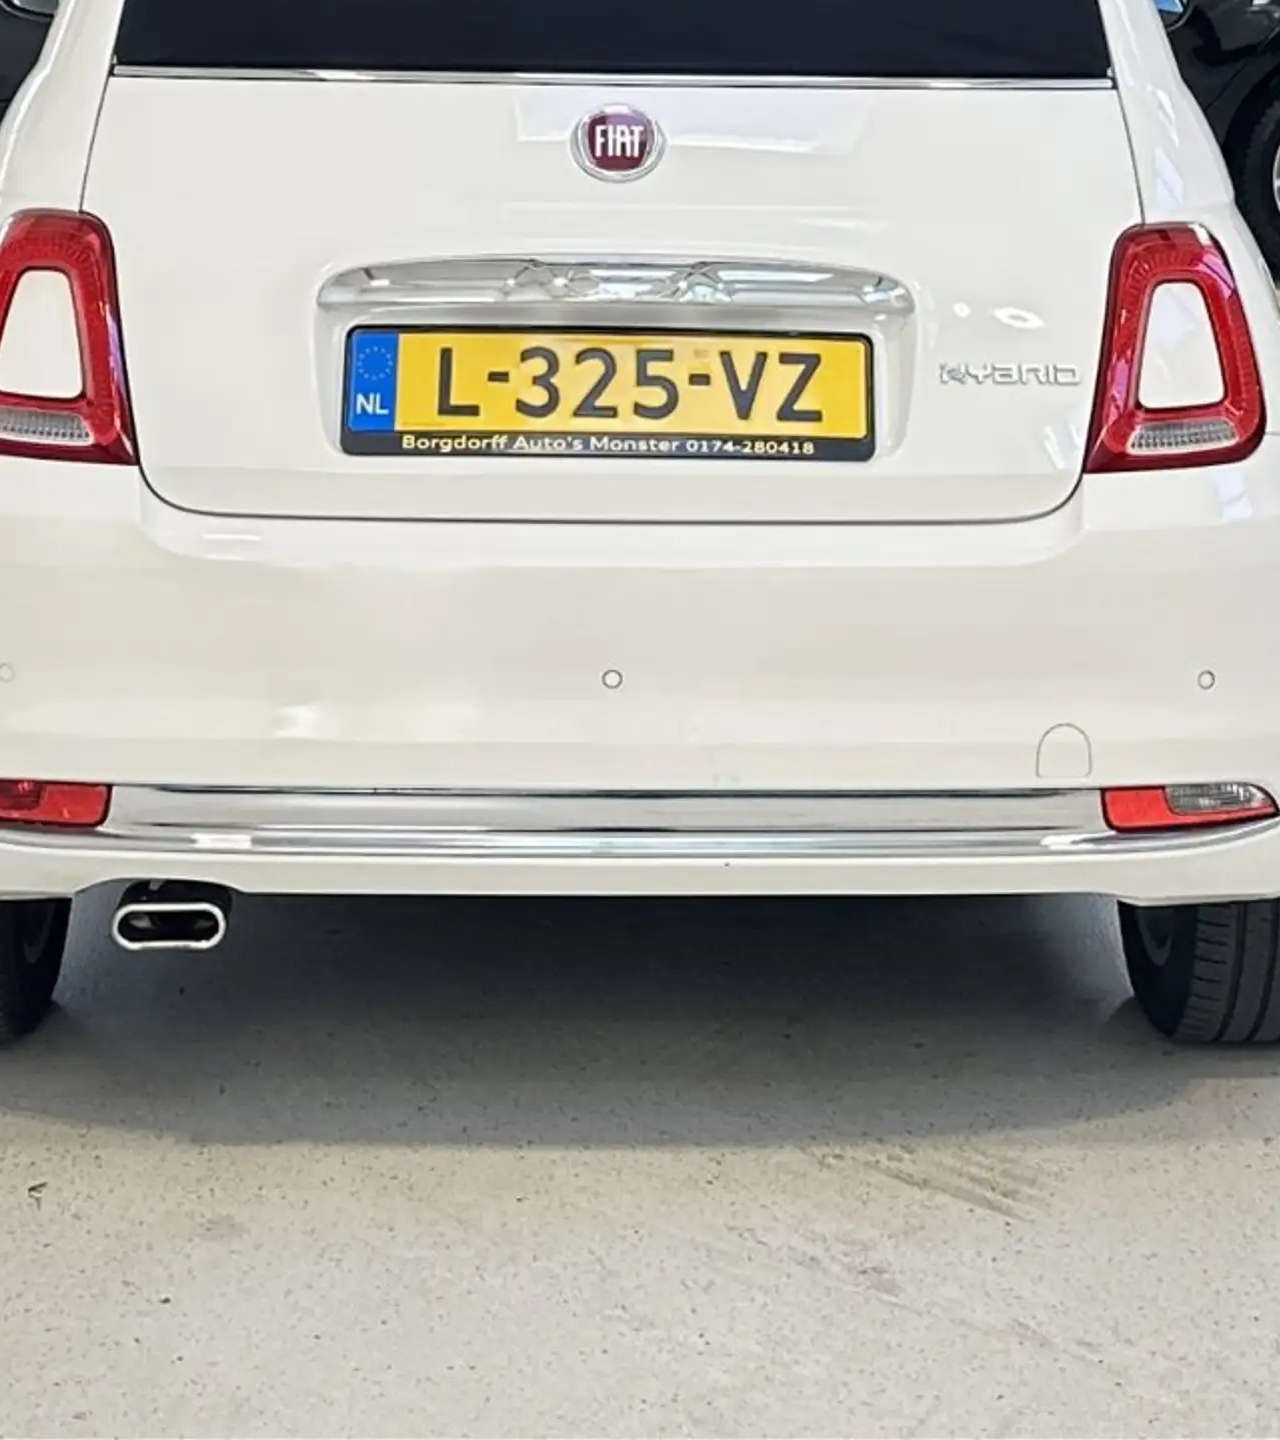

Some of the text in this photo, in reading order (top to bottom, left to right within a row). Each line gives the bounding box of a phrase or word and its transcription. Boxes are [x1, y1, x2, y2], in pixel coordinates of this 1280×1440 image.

[595, 124, 645, 158] FIAT
[437, 346, 823, 422] L-325-VZ
[939, 363, 1082, 386] HYBRID
[356, 392, 389, 415] NL
[402, 434, 814, 455] Borgdorff Auto's Monster 0174-280418
